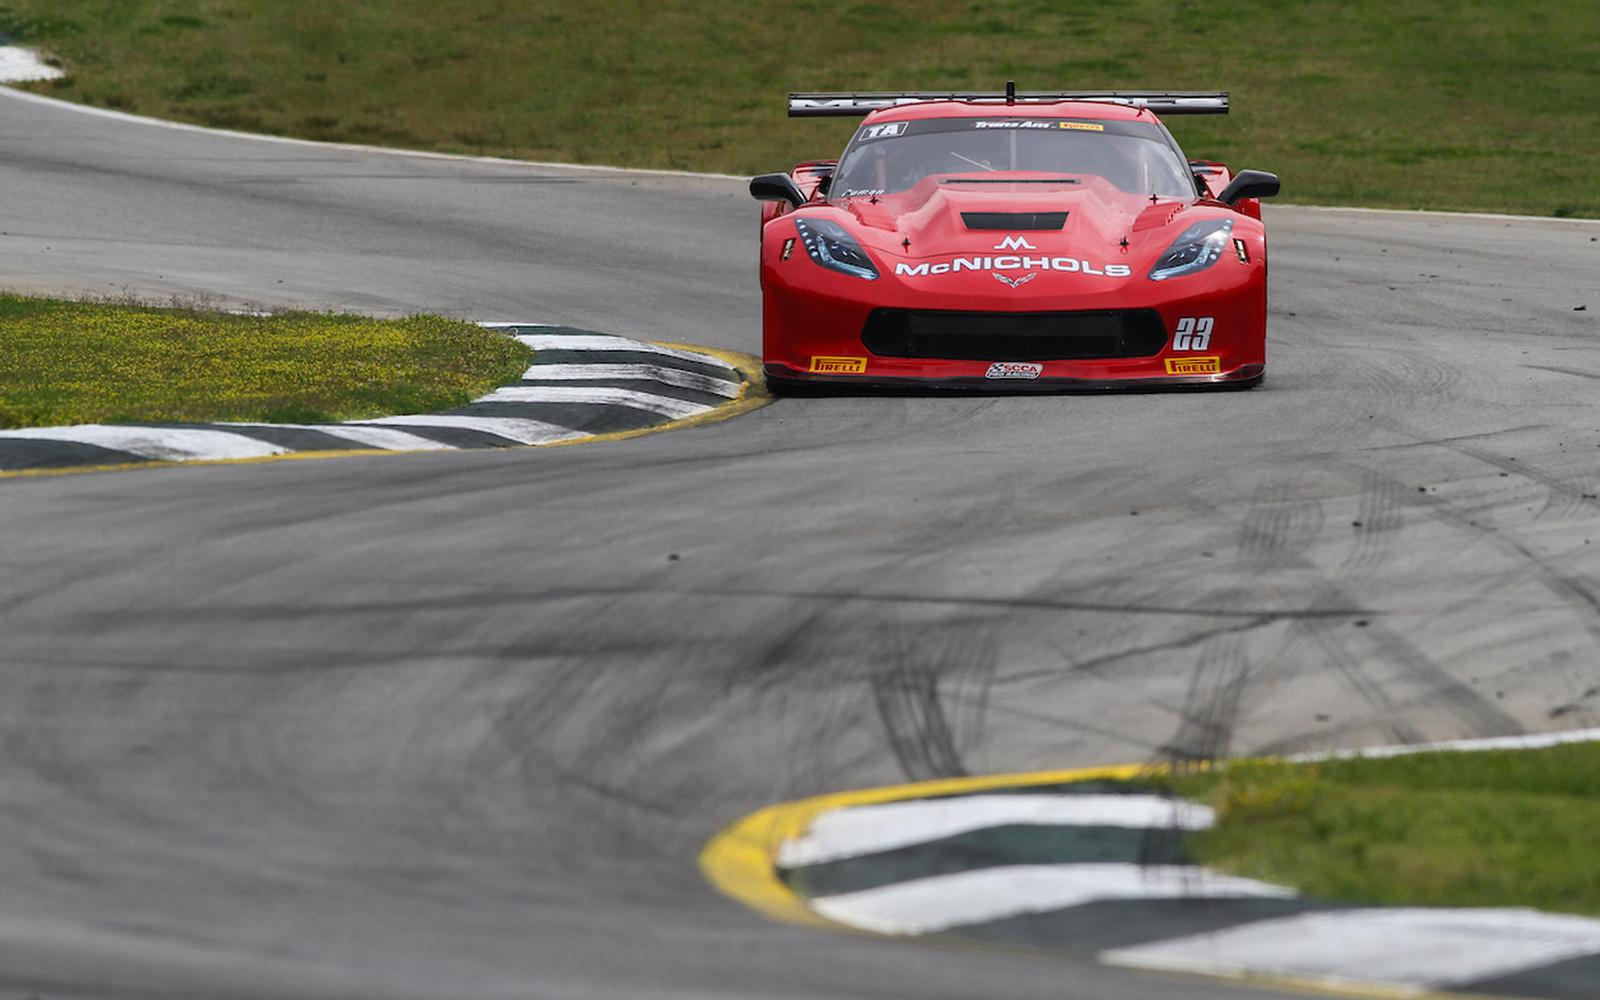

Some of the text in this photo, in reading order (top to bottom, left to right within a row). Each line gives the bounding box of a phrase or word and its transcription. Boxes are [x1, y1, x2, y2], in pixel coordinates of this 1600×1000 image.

[868, 124, 899, 138] TA
[895, 256, 1131, 277] McNICHOLS
[1172, 317, 1215, 351] 23
[814, 358, 862, 372] PIRELLI
[1004, 364, 1038, 373] SCCA
[1169, 359, 1216, 372] PIRELLI
